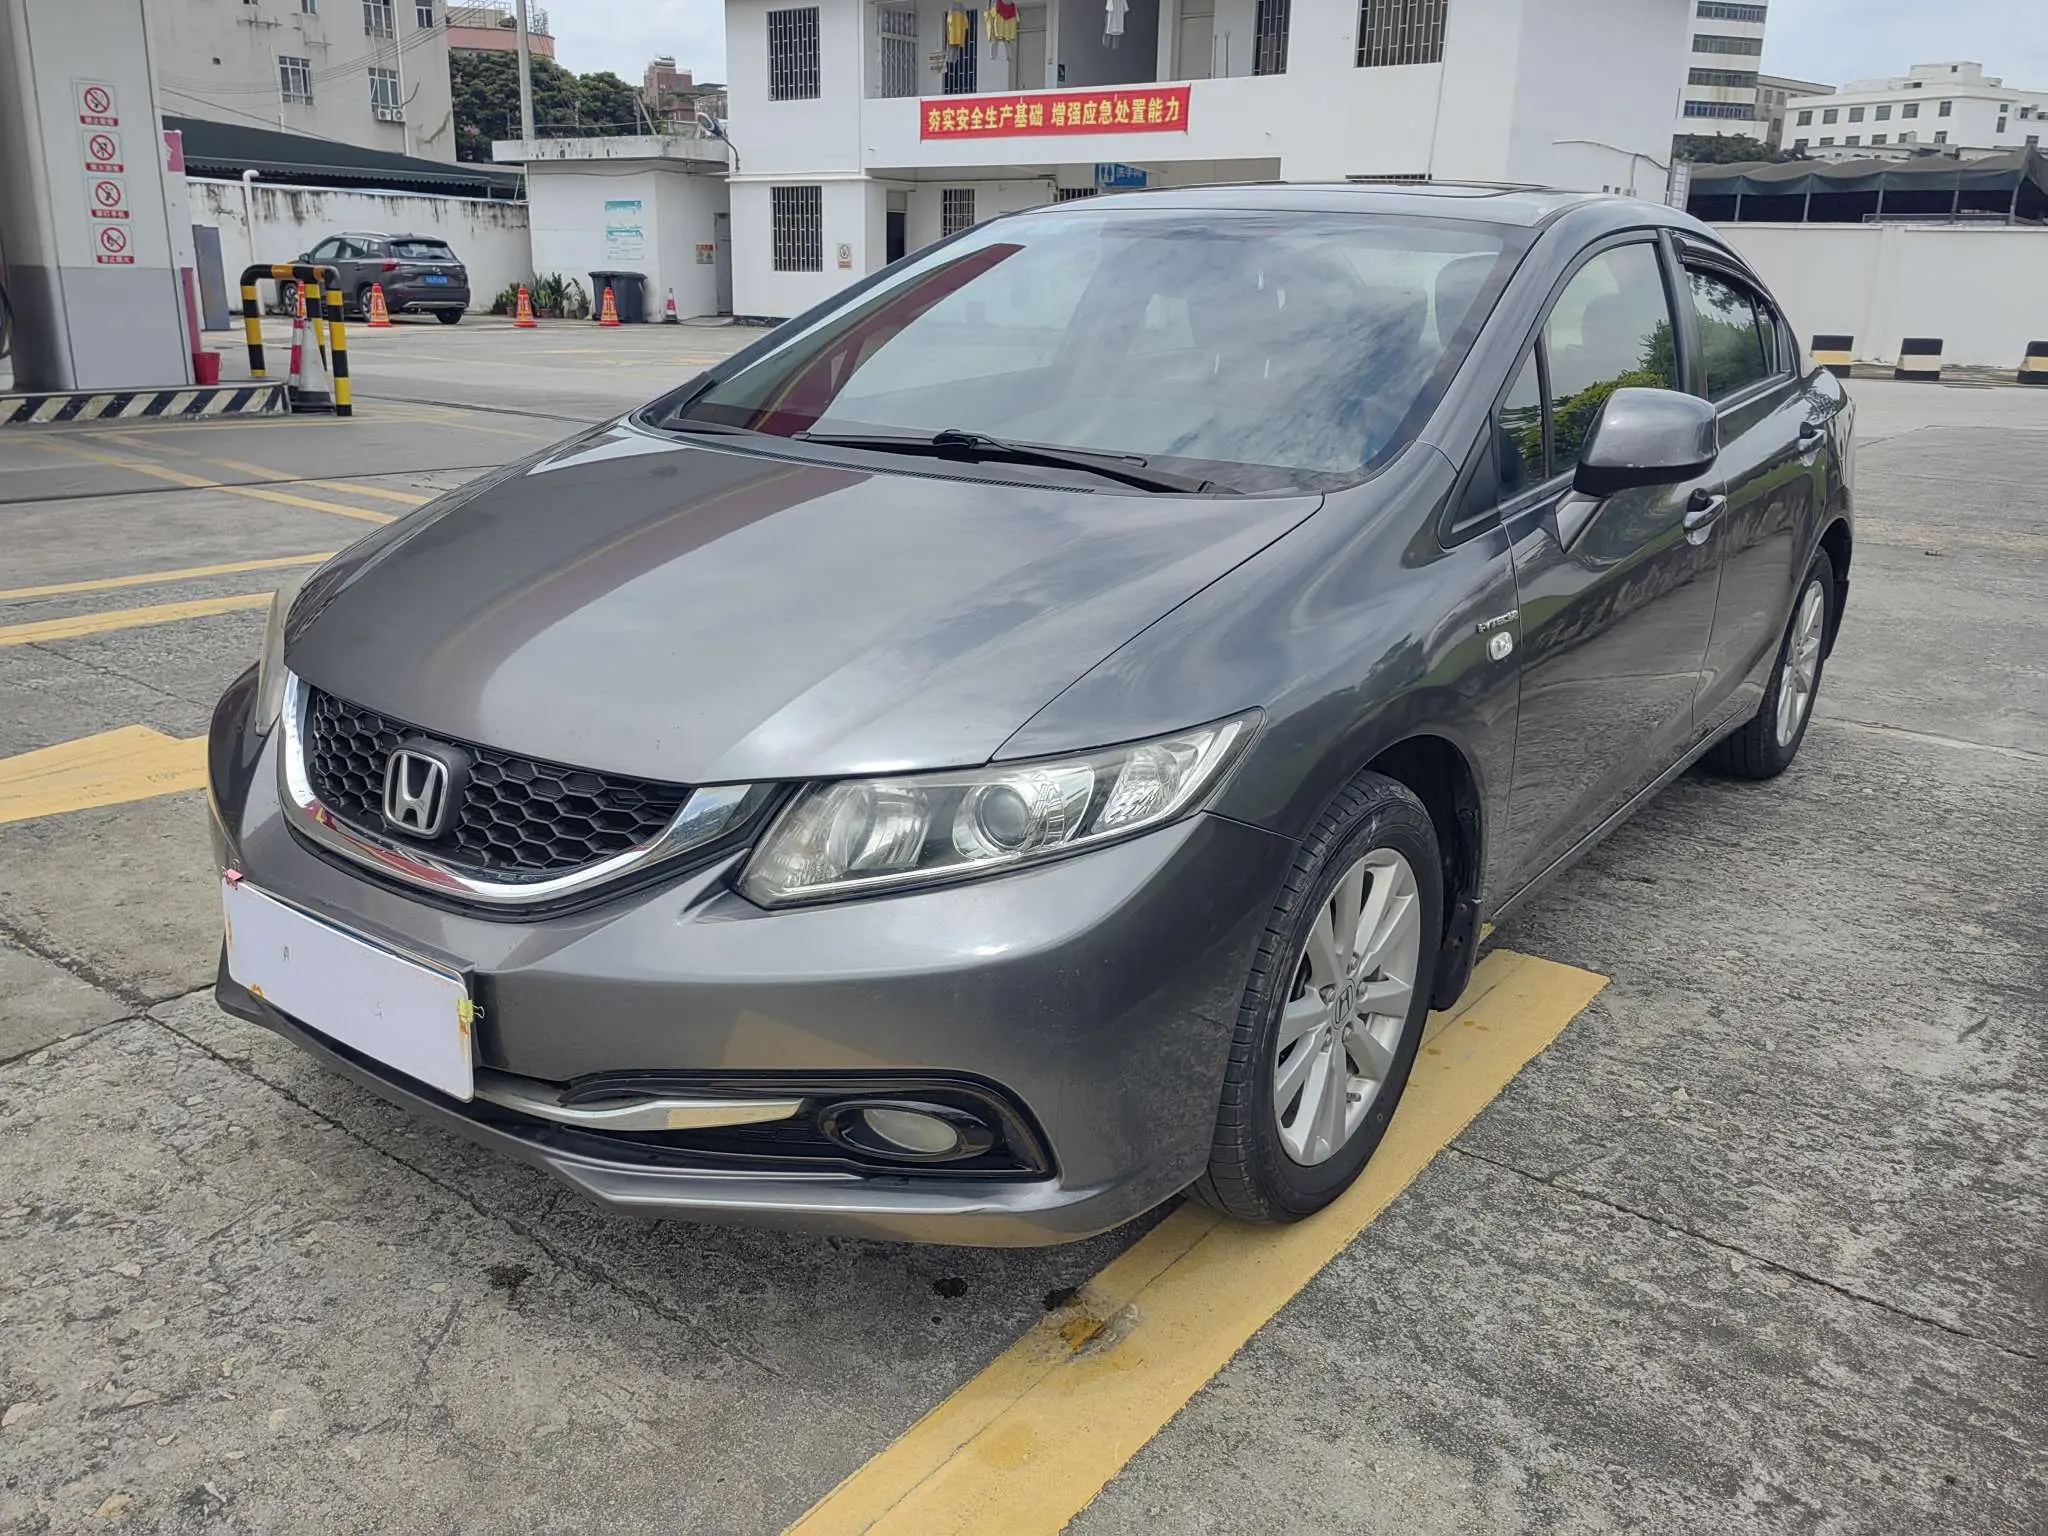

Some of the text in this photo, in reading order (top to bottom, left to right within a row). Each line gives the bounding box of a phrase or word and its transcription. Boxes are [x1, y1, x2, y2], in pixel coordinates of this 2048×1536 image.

[928, 96, 1180, 132] 夯实安全生产基础 增强应急处置能力
